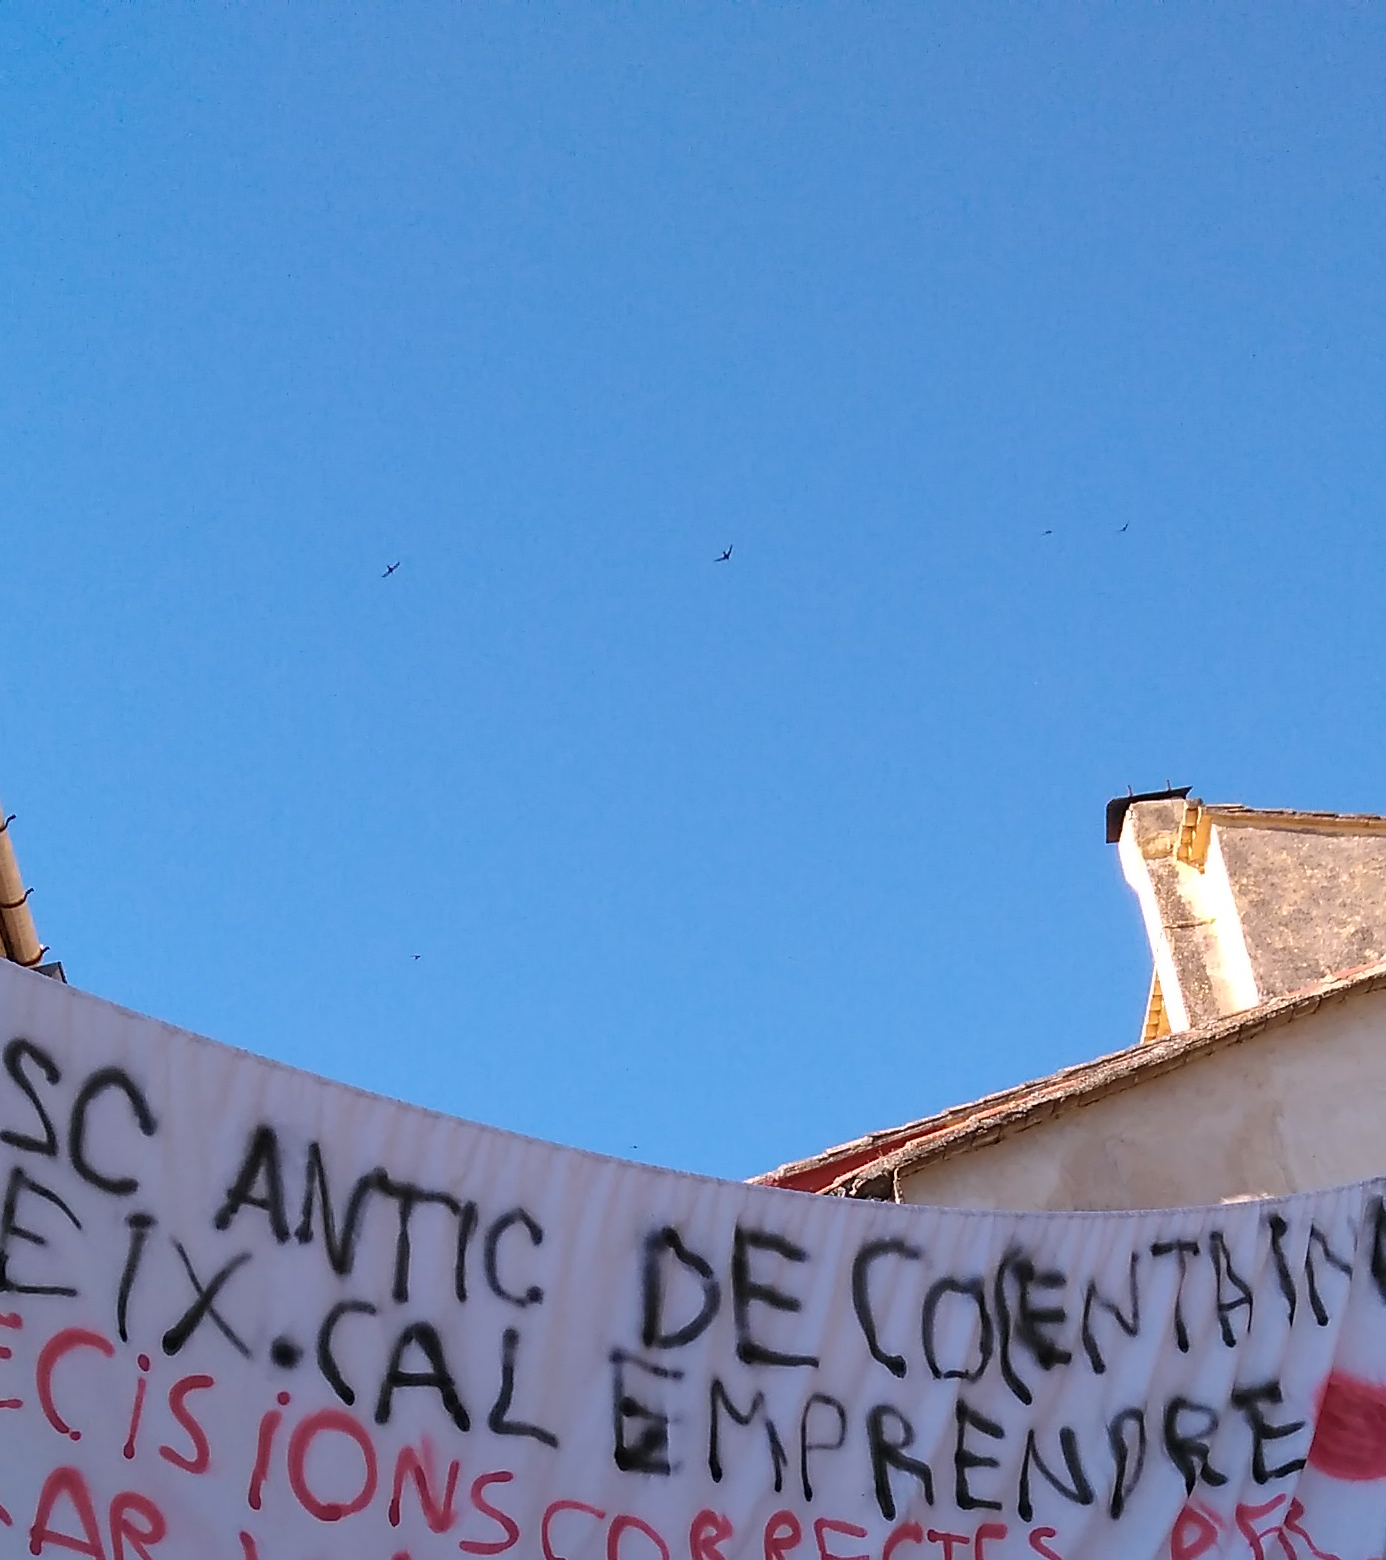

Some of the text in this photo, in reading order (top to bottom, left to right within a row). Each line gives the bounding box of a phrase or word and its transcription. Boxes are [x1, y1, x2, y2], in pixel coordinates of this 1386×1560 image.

[215, 1123, 545, 1308] ANTIC
[640, 1226, 820, 1369] DE
[609, 1347, 1307, 1521] EMPRENDRE
